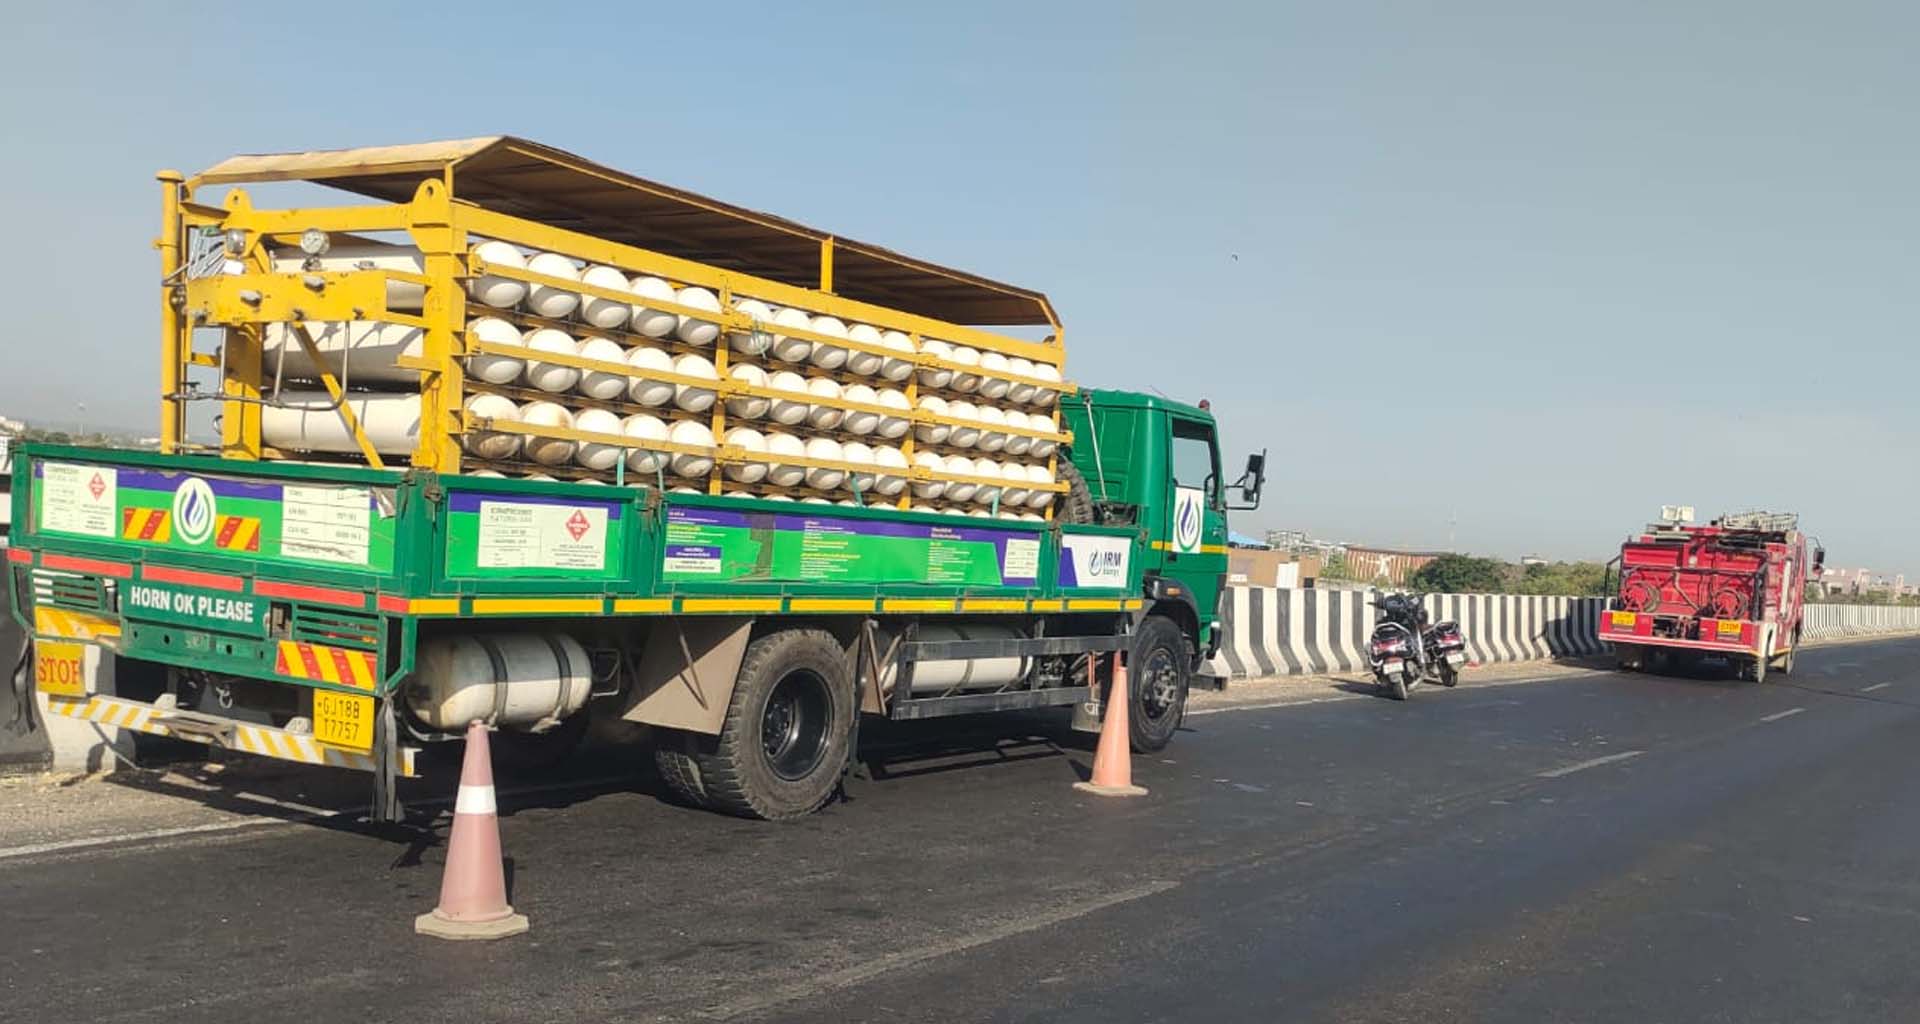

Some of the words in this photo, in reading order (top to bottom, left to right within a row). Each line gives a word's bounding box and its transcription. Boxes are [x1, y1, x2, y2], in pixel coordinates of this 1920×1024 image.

[1103, 552, 1121, 566] IRM
[131, 586, 170, 611] HORN
[174, 593, 195, 615] OK
[198, 596, 254, 623] PLEASE
